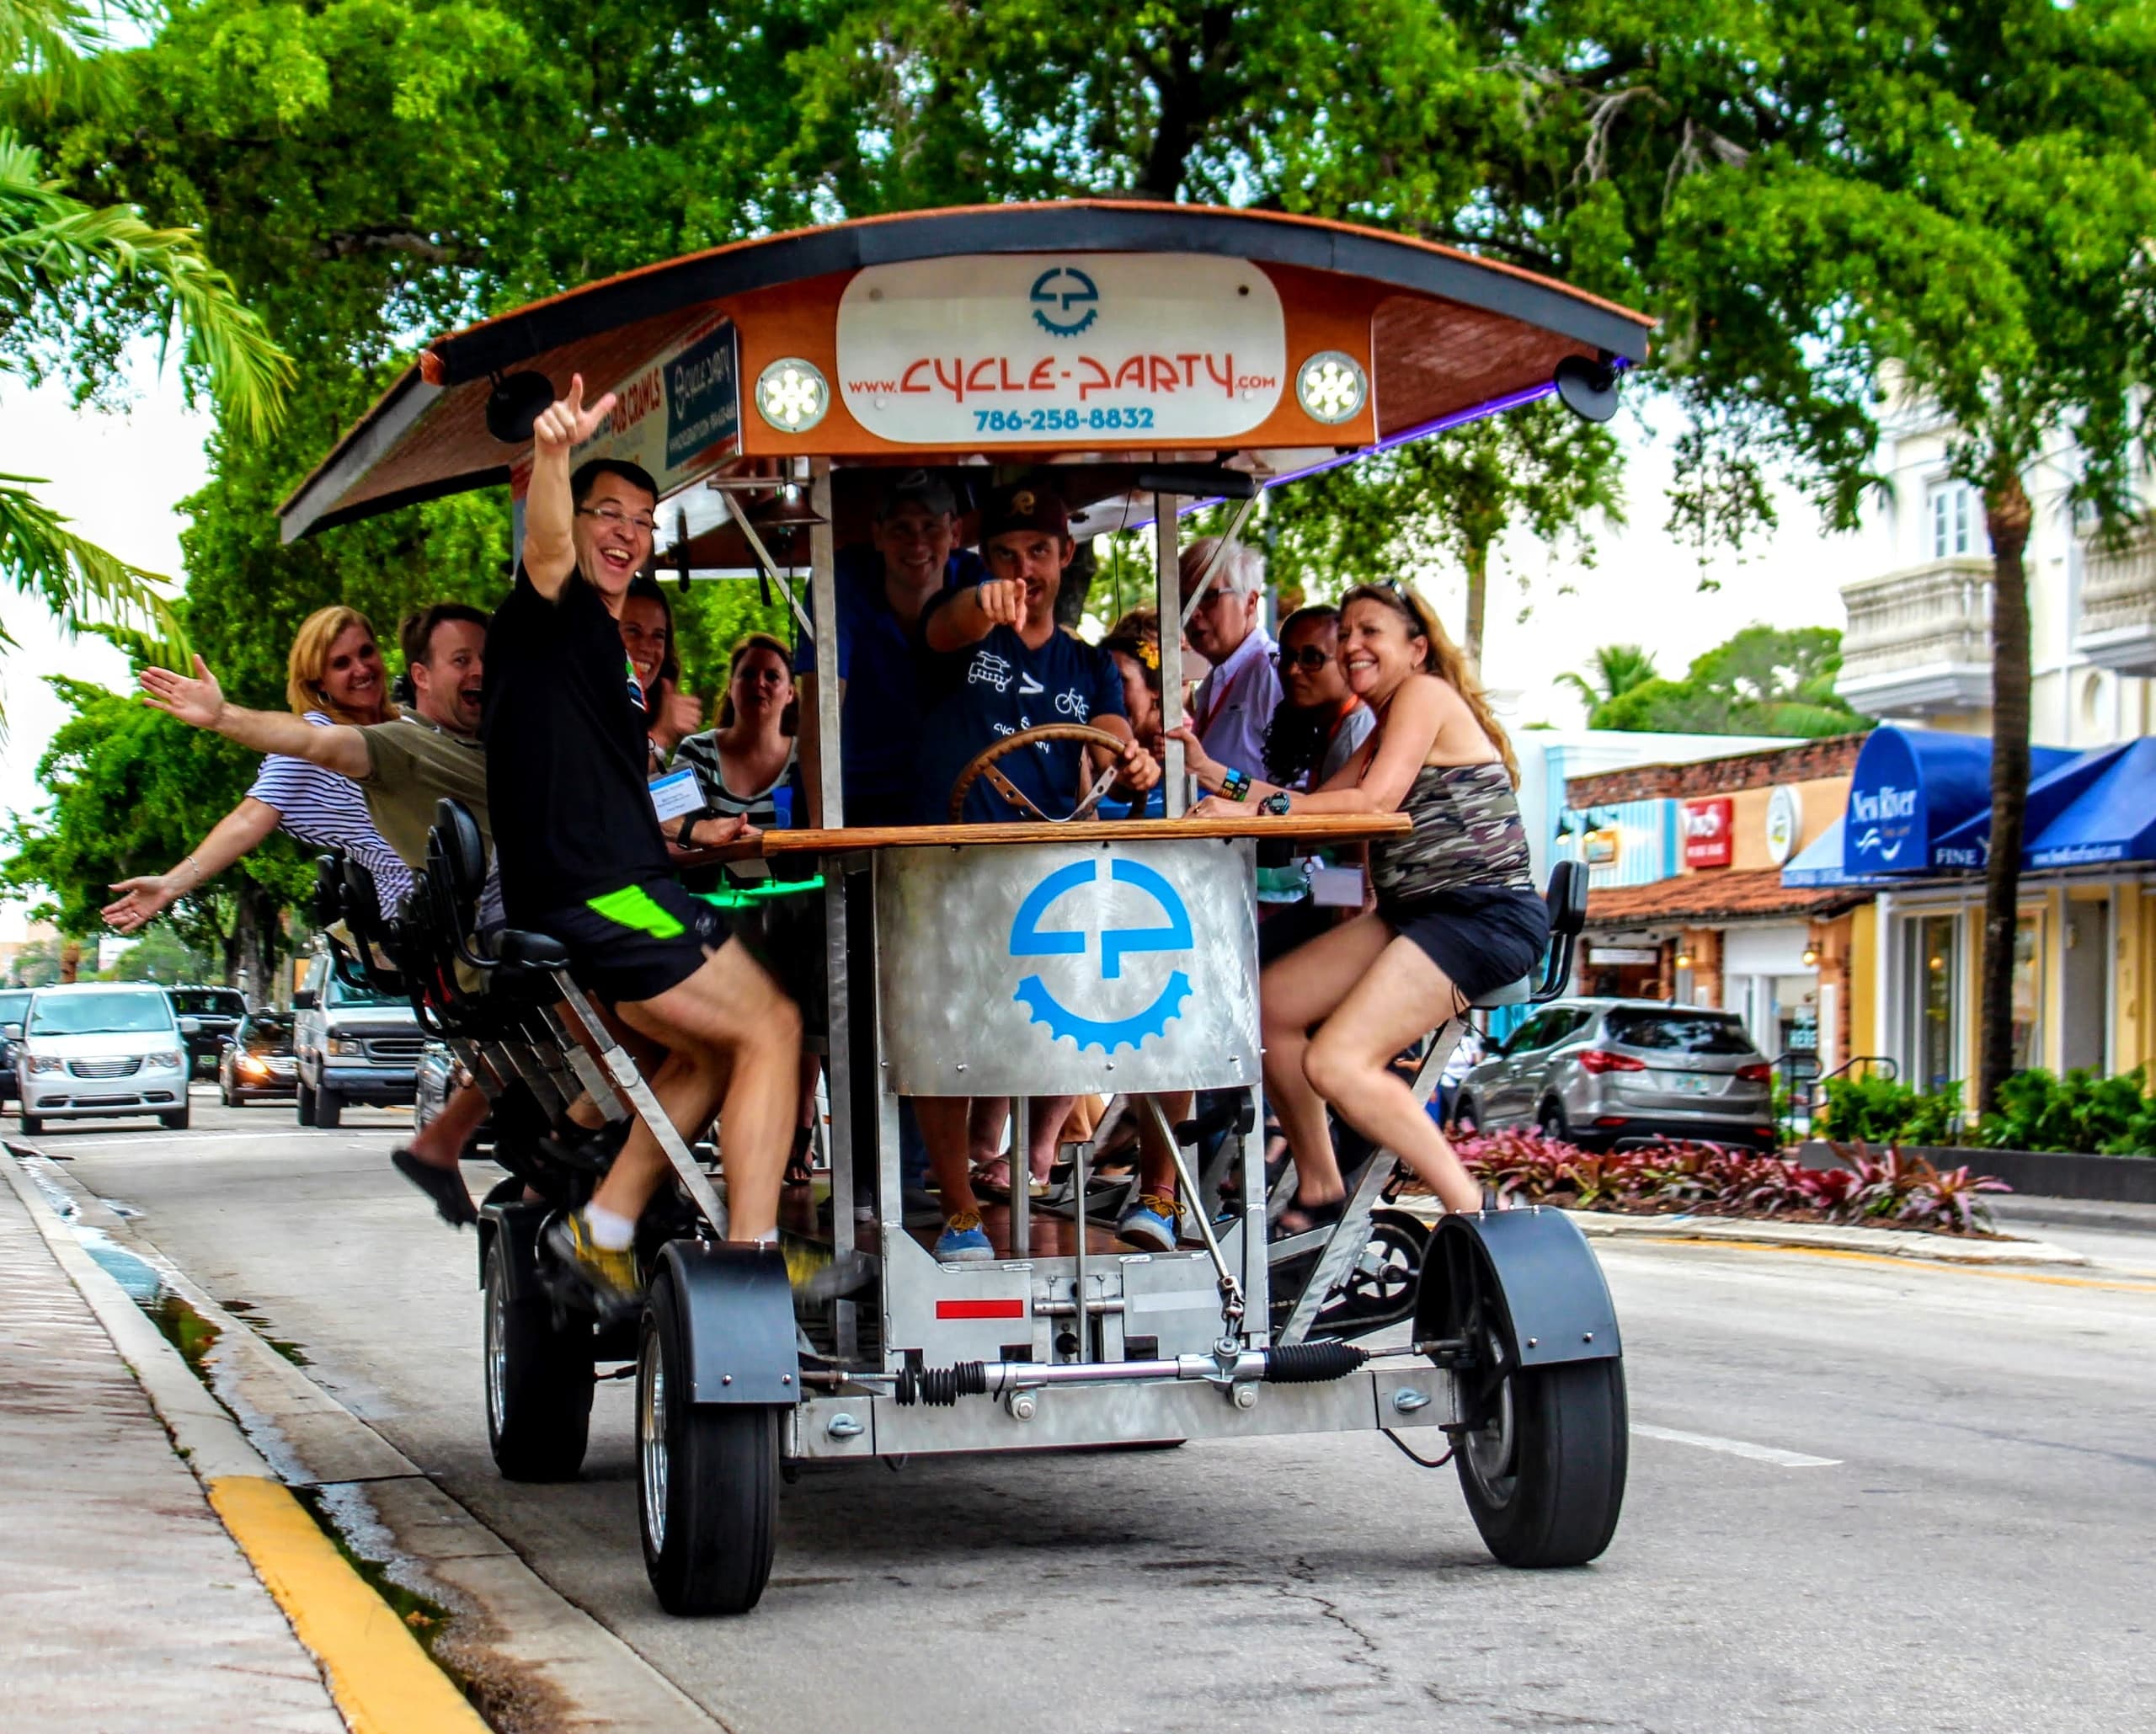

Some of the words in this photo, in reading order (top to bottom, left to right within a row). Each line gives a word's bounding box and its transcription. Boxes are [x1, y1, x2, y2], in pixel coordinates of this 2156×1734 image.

[627, 367, 660, 425] CRAWLS
[974, 407, 1155, 432] 786-258-8832
[1936, 848, 1977, 865] FINE
